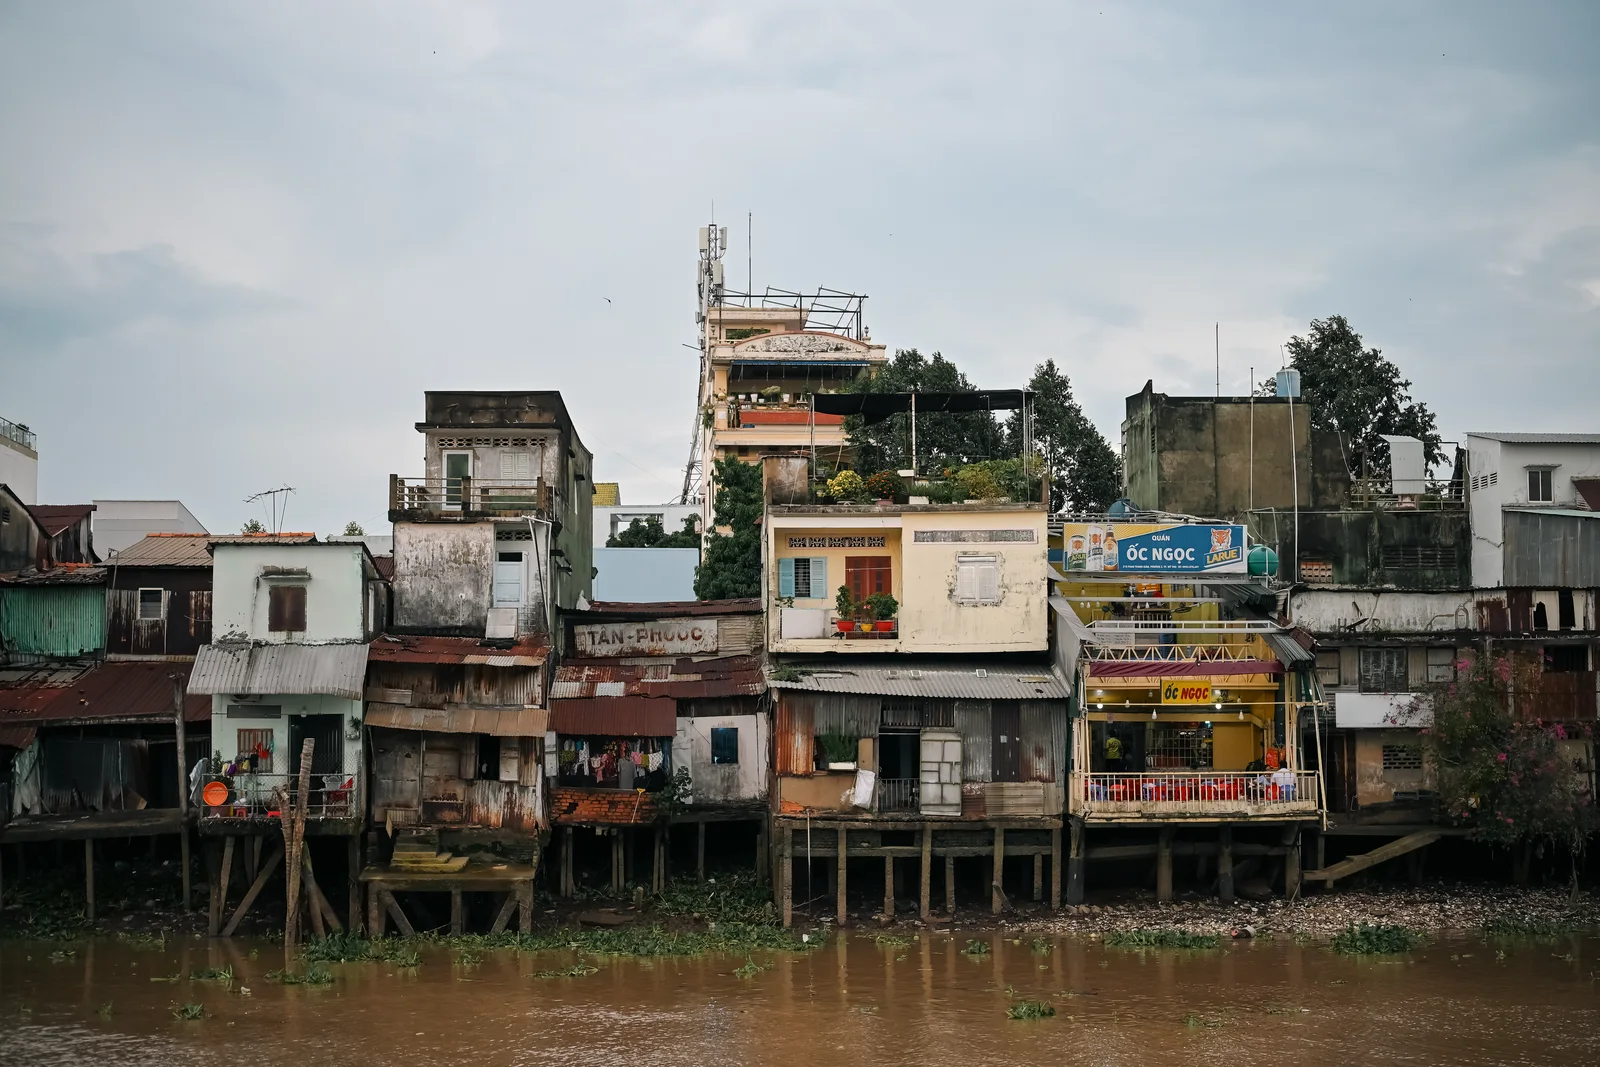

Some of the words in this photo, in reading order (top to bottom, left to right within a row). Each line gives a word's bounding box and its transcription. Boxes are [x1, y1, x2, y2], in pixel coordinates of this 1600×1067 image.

[1151, 534, 1170, 542] QUÁN
[1126, 543, 1148, 561] ỐC
[1152, 547, 1195, 564] NGỌC
[1206, 549, 1238, 564] LARUE
[1165, 683, 1179, 700] ỐC
[1180, 687, 1209, 702] NGỌC
